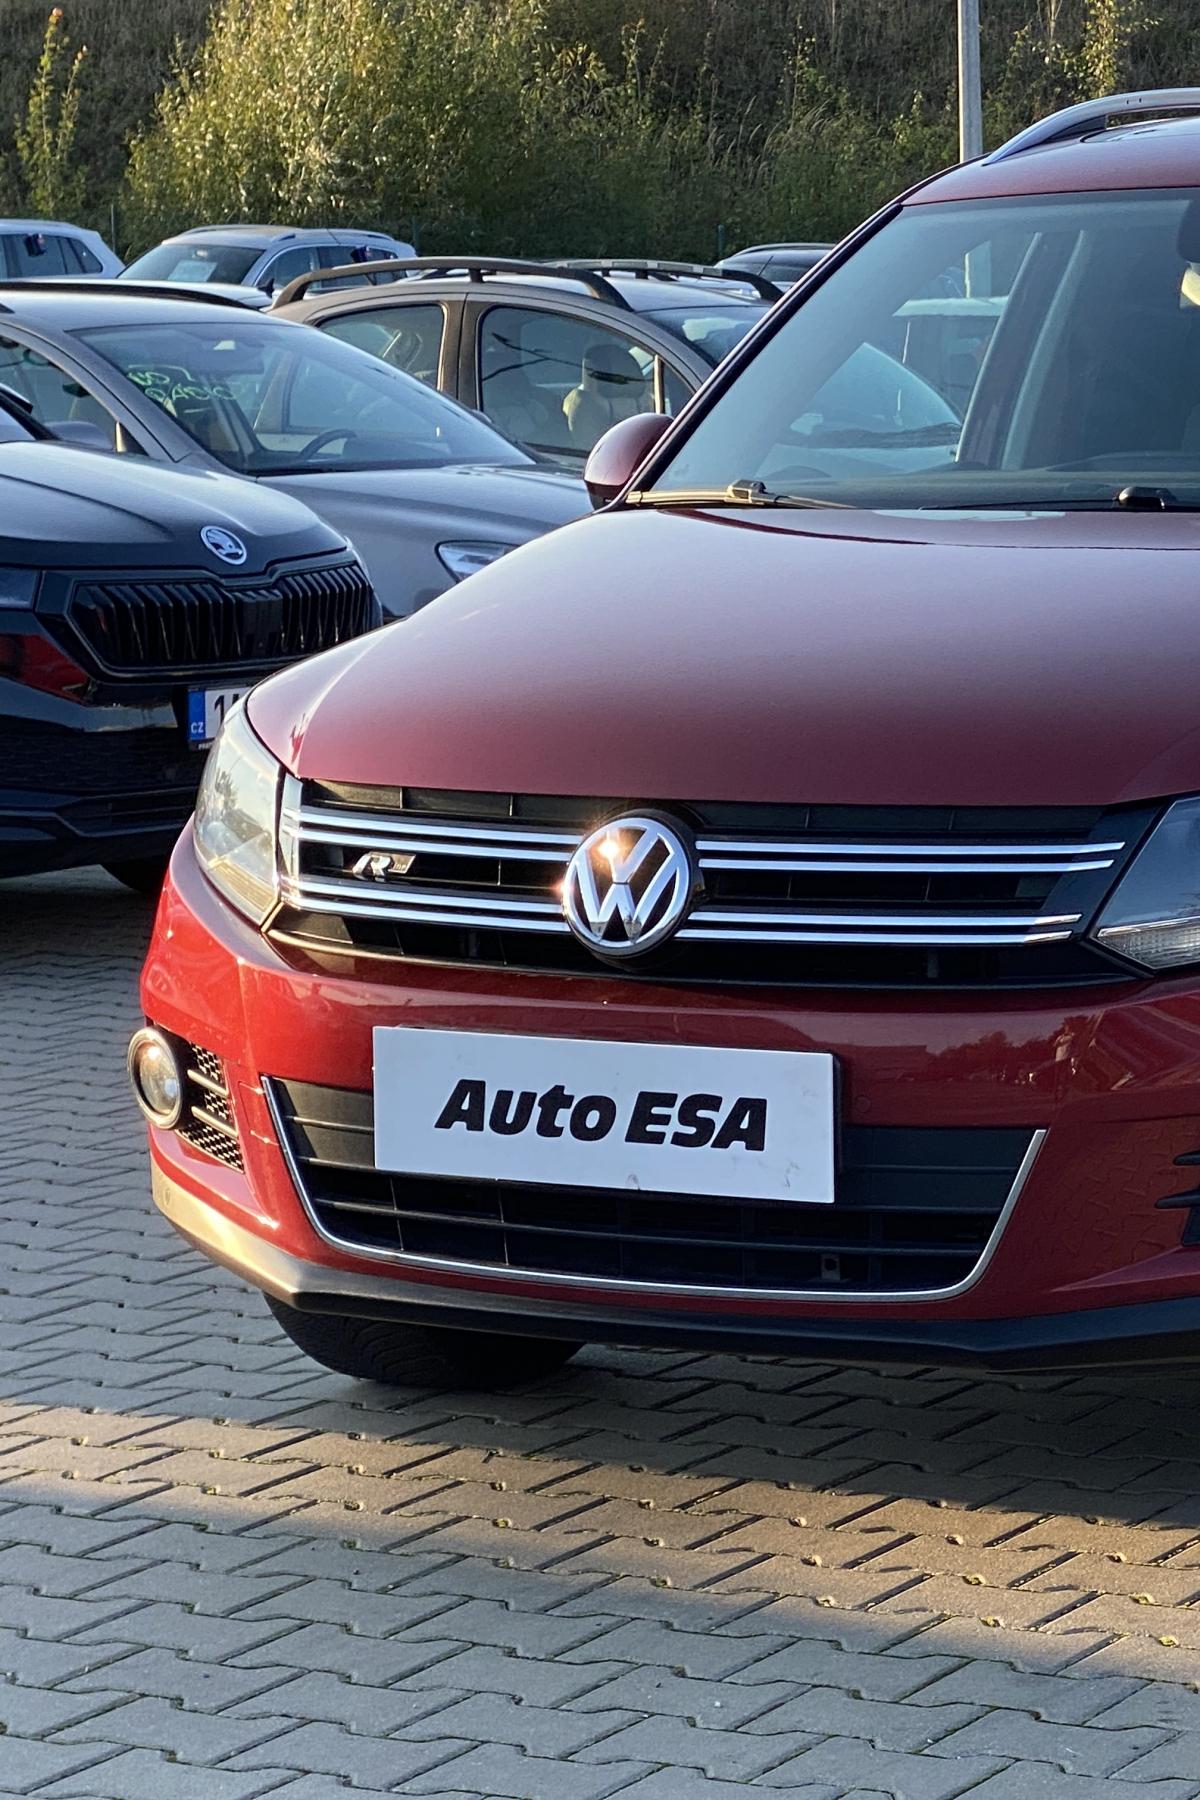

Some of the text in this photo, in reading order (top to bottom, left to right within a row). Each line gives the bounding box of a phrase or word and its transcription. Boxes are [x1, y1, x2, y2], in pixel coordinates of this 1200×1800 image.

[190, 721, 204, 734] CZ
[434, 1078, 768, 1152] Auto ESA
